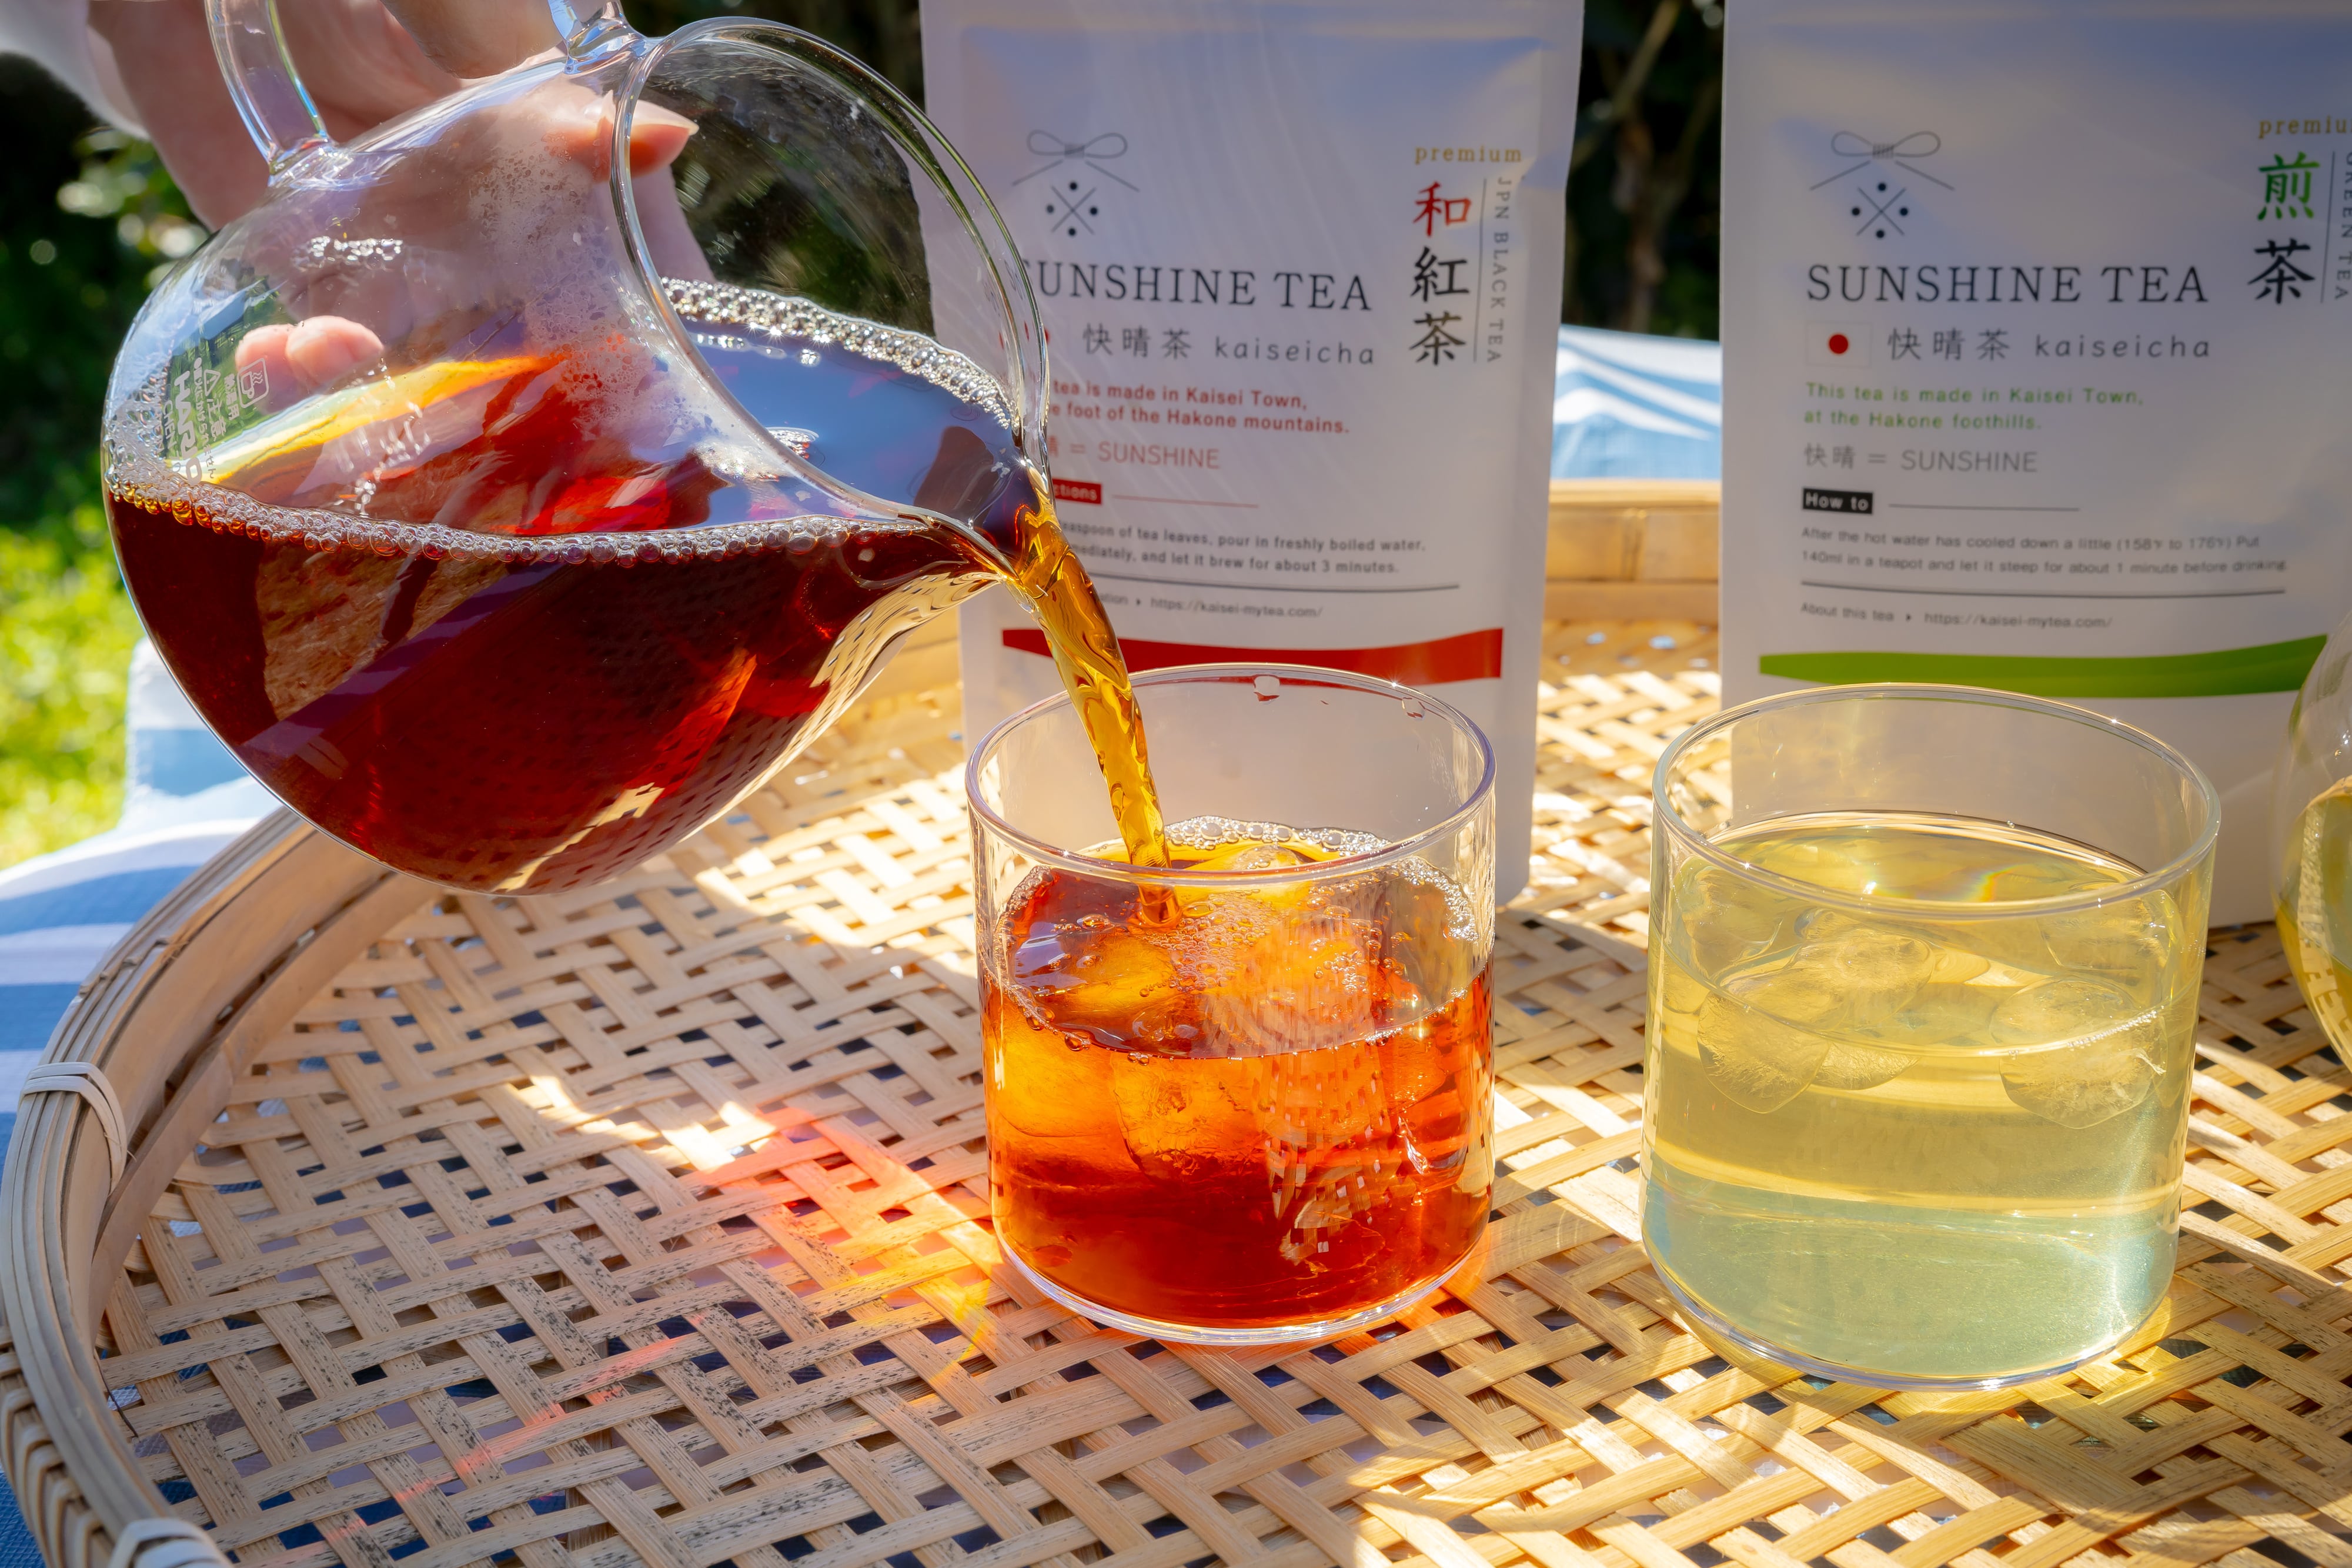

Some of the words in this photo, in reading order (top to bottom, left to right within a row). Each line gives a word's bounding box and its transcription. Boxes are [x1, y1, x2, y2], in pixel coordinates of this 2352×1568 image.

[2259, 115, 2352, 138] premiu
[1415, 145, 1522, 165] premium
[1495, 177, 1512, 219] JPN
[2247, 152, 2320, 304] 煎茶
[1022, 259, 1255, 305] UNSHINE
[1274, 272, 1372, 311] TEA
[1409, 180, 1472, 366] 和紅茶
[1491, 232, 1509, 309] BLACK
[1807, 265, 2081, 302] SUNSHINE
[2101, 266, 2208, 303] TEA
[2335, 251, 2352, 300] TEA
[1083, 323, 1192, 359] 快晴茶
[1215, 336, 1374, 365] kaiseicha
[1488, 319, 1504, 363] TEA
[1887, 327, 2010, 360] 快晴茶
[2036, 335, 2209, 357] kaiseicha
[1053, 381, 1080, 396] tea
[1087, 382, 1100, 397] is
[1107, 385, 1155, 400] made
[1162, 386, 1179, 402] in
[1187, 387, 1243, 405] Kaisei
[1251, 390, 1307, 411] Town,
[1806, 382, 1845, 399] This
[1855, 386, 1883, 402] tea
[1893, 386, 1909, 402] is
[1920, 387, 1972, 403] made
[1982, 387, 1999, 403] in
[2010, 387, 2073, 404] Kaisei
[2083, 387, 2143, 406] Town,
[174, 371, 202, 486] HARIO
[1067, 401, 1100, 420] foot
[1107, 406, 1124, 421] of
[1131, 407, 1160, 424] the
[1167, 410, 1237, 428] Hakone
[1244, 416, 1349, 433] mountains.
[1805, 410, 1821, 424] at
[1831, 411, 1859, 426] the
[1869, 412, 1943, 429] Hakone
[1953, 413, 2041, 430] foothills.
[1098, 441, 1220, 469] SUNSHINE
[1804, 443, 1856, 469] 快晴
[1900, 449, 2037, 472] SUNSHINE
[1805, 492, 1843, 509] How
[1851, 497, 1869, 511] to
[1119, 526, 1132, 539] of
[1137, 527, 1158, 540] tea
[1164, 530, 1213, 546] leaves,
[1218, 536, 1250, 547] pour
[1256, 535, 1268, 548] in
[1275, 536, 1324, 553] freshly
[1329, 539, 1375, 551] boiled
[1380, 539, 1426, 552] water.
[1802, 527, 1832, 540] After
[1839, 531, 1859, 543] the
[1865, 533, 1886, 544] hot
[1892, 536, 1929, 547] water
[1936, 535, 1960, 547] has
[1966, 537, 2015, 549] cooled
[2020, 537, 2059, 549] down
[2063, 539, 2073, 550] a
[2078, 537, 2112, 550] little
[2169, 539, 2182, 550] to
[2236, 535, 2259, 548] Put
[1142, 550, 1166, 563] and
[1171, 551, 1189, 565] let
[1195, 554, 1204, 566] it
[1210, 554, 1244, 569] brew
[1250, 557, 1269, 570] for
[1275, 559, 1316, 572] about
[1322, 560, 1329, 572] 3
[1336, 561, 1399, 574] minutes.
[1847, 555, 1860, 566] in
[1865, 557, 1873, 567] a
[1879, 557, 1923, 570] teapot
[1928, 560, 1955, 571] and
[1960, 560, 1977, 571] let
[1984, 560, 1993, 572] it
[2000, 561, 2039, 574] steep
[2044, 560, 2062, 573] for
[2069, 562, 2109, 574] about
[2130, 562, 2178, 574] minute
[2183, 561, 2227, 573] before
[1802, 602, 1837, 617] About
[1843, 607, 1866, 619] this
[1873, 610, 1895, 622] tea
